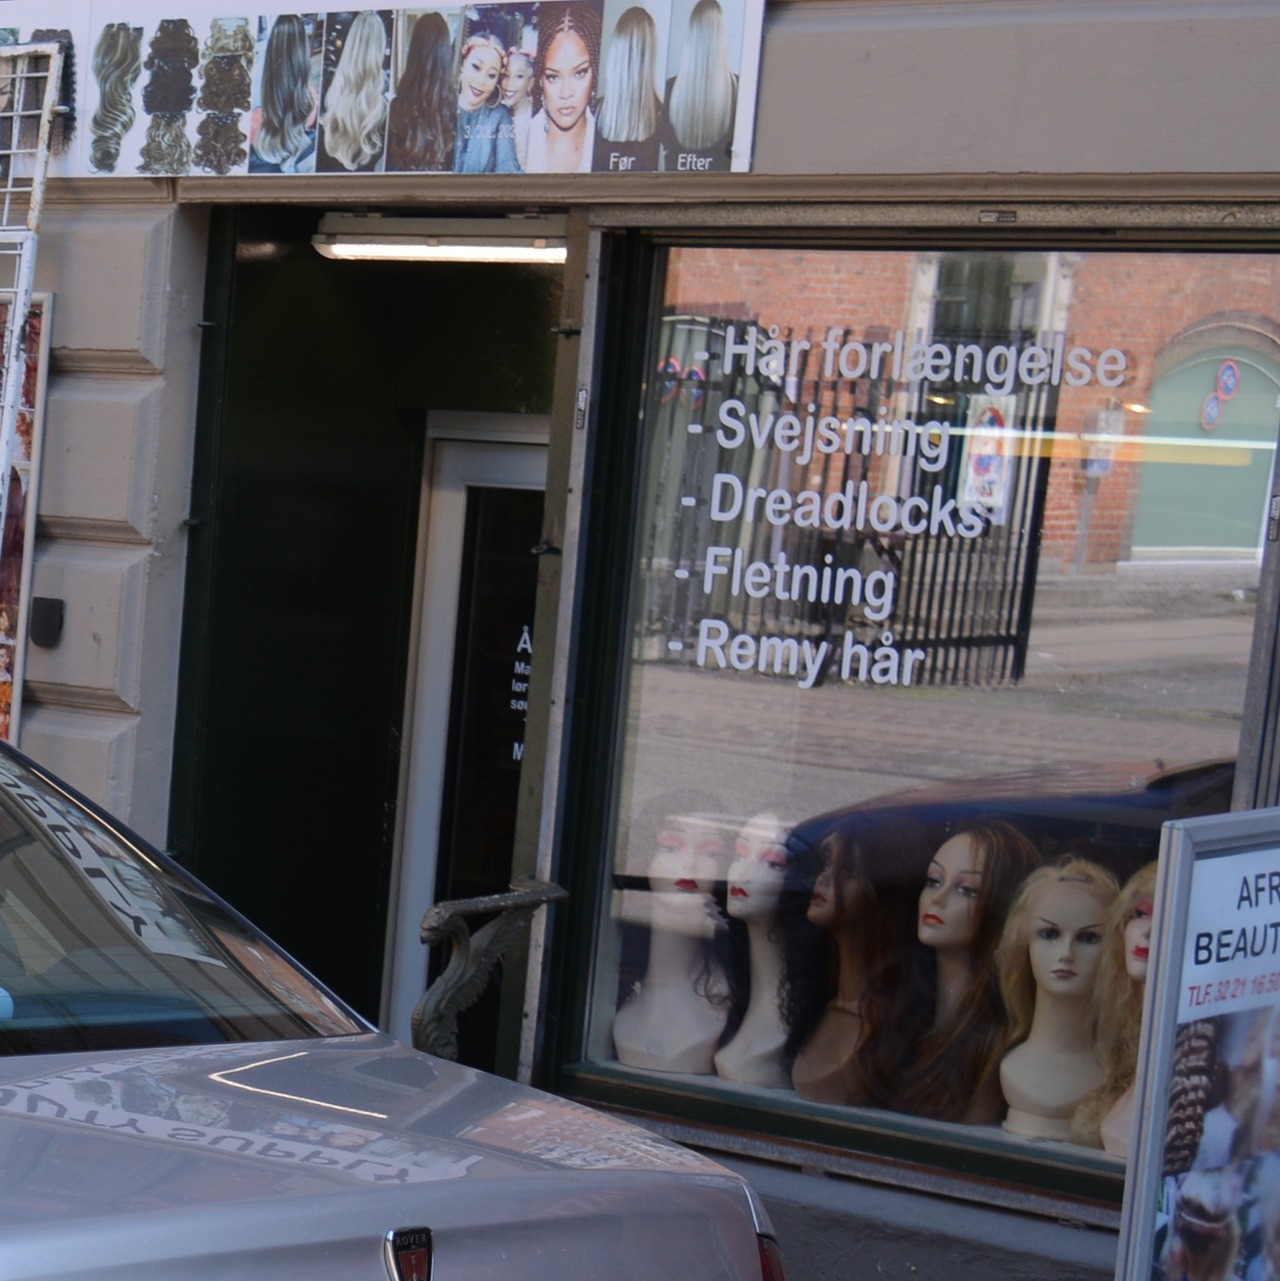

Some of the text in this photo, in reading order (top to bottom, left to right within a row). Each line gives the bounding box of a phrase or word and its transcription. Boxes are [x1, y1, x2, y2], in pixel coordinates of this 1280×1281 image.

[608, 152, 637, 171] Før
[676, 153, 713, 171] Efter
[722, 323, 811, 378] Hår
[822, 327, 1128, 396] forlængelse
[715, 398, 951, 472] Svejsning
[709, 472, 985, 539] Dreadlocks
[702, 546, 895, 622] Fletning
[696, 618, 829, 689] Remy
[840, 629, 926, 687] hår
[1236, 870, 1280, 911] AFR
[1194, 921, 1280, 966] BEAUT
[1188, 983, 1211, 1008] TLF.
[1214, 978, 1230, 1002] 32
[1230, 977, 1247, 999] 21
[396, 1233, 428, 1247] ROVER
